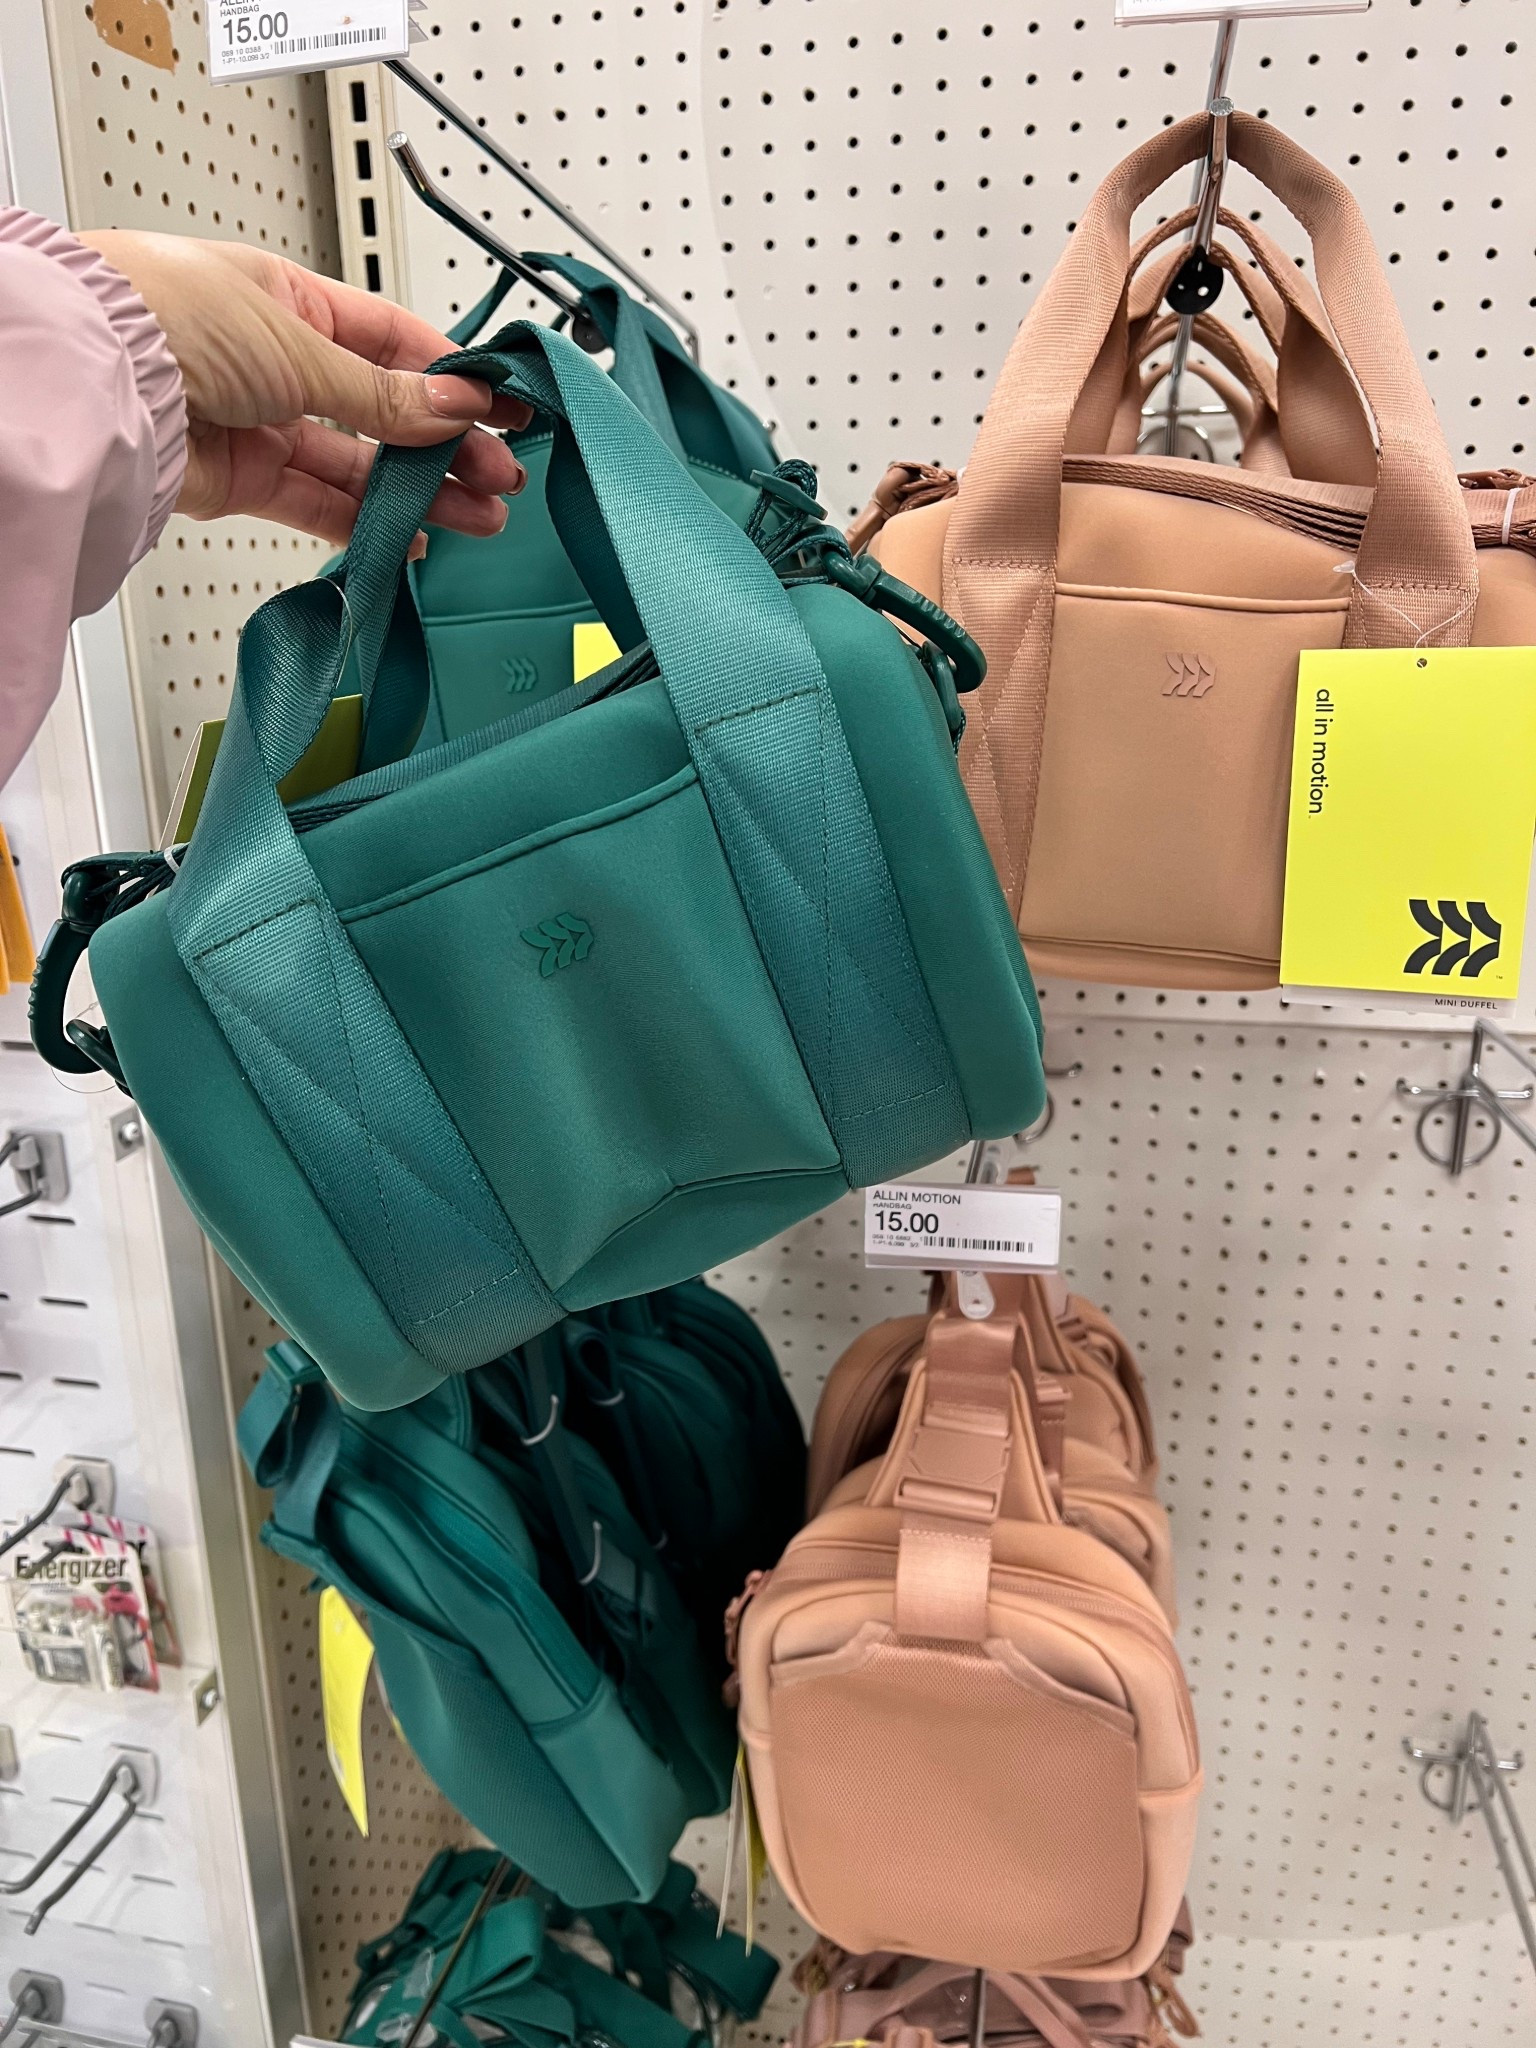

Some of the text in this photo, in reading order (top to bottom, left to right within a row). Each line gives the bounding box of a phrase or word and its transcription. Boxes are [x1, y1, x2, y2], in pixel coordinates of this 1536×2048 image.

[220, 4, 260, 17] HANDBAG
[223, 11, 288, 45] 15.00
[1308, 688, 1335, 814] all in motion
[1434, 998, 1498, 1010] MINI DUFFEL
[873, 1190, 961, 1205] ALLIN MOTION
[875, 1210, 939, 1234] 15.00
